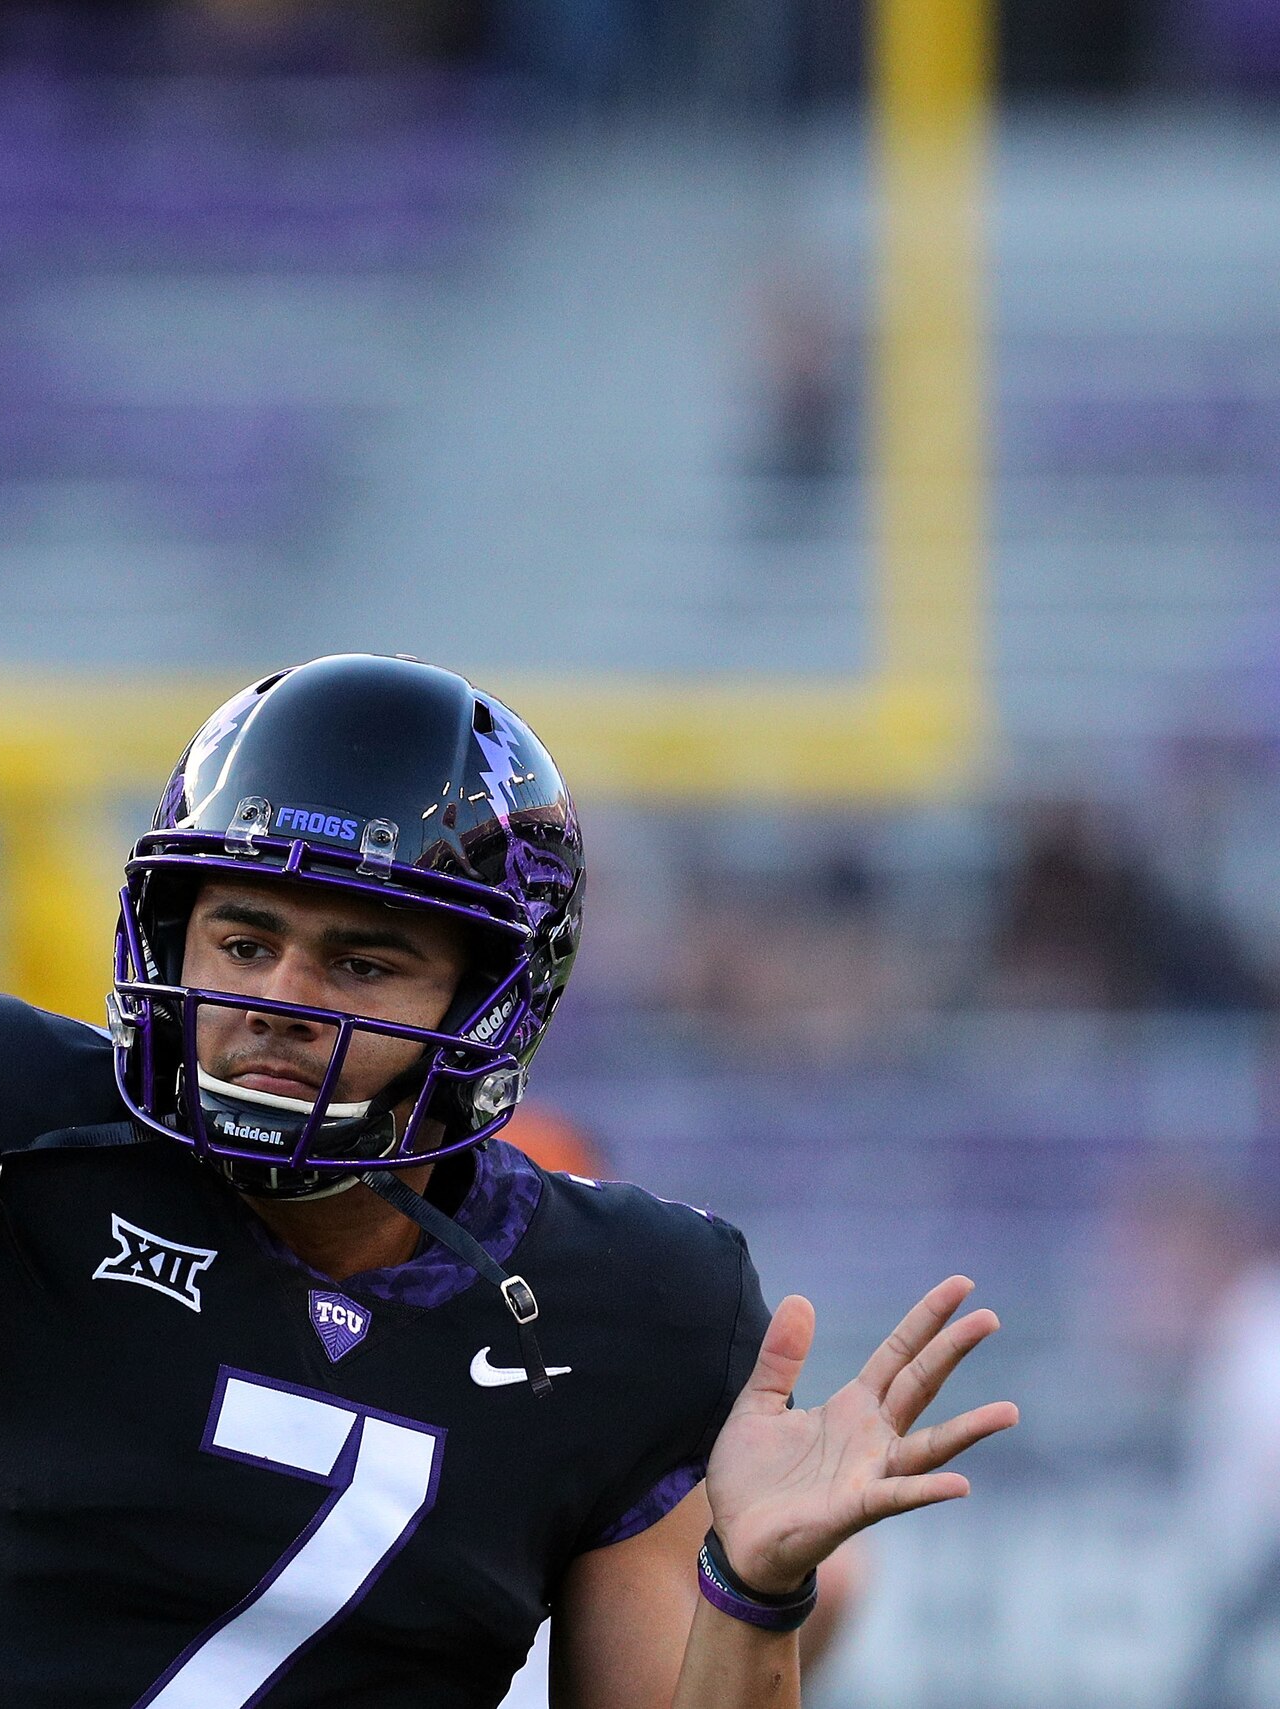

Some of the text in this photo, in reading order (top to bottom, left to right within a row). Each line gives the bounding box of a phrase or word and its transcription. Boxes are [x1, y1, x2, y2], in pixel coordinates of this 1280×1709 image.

[276, 807, 357, 841] FROGS
[93, 1213, 217, 1312] XII
[317, 1302, 363, 1334] TCU
[132, 1364, 448, 1709] 7
